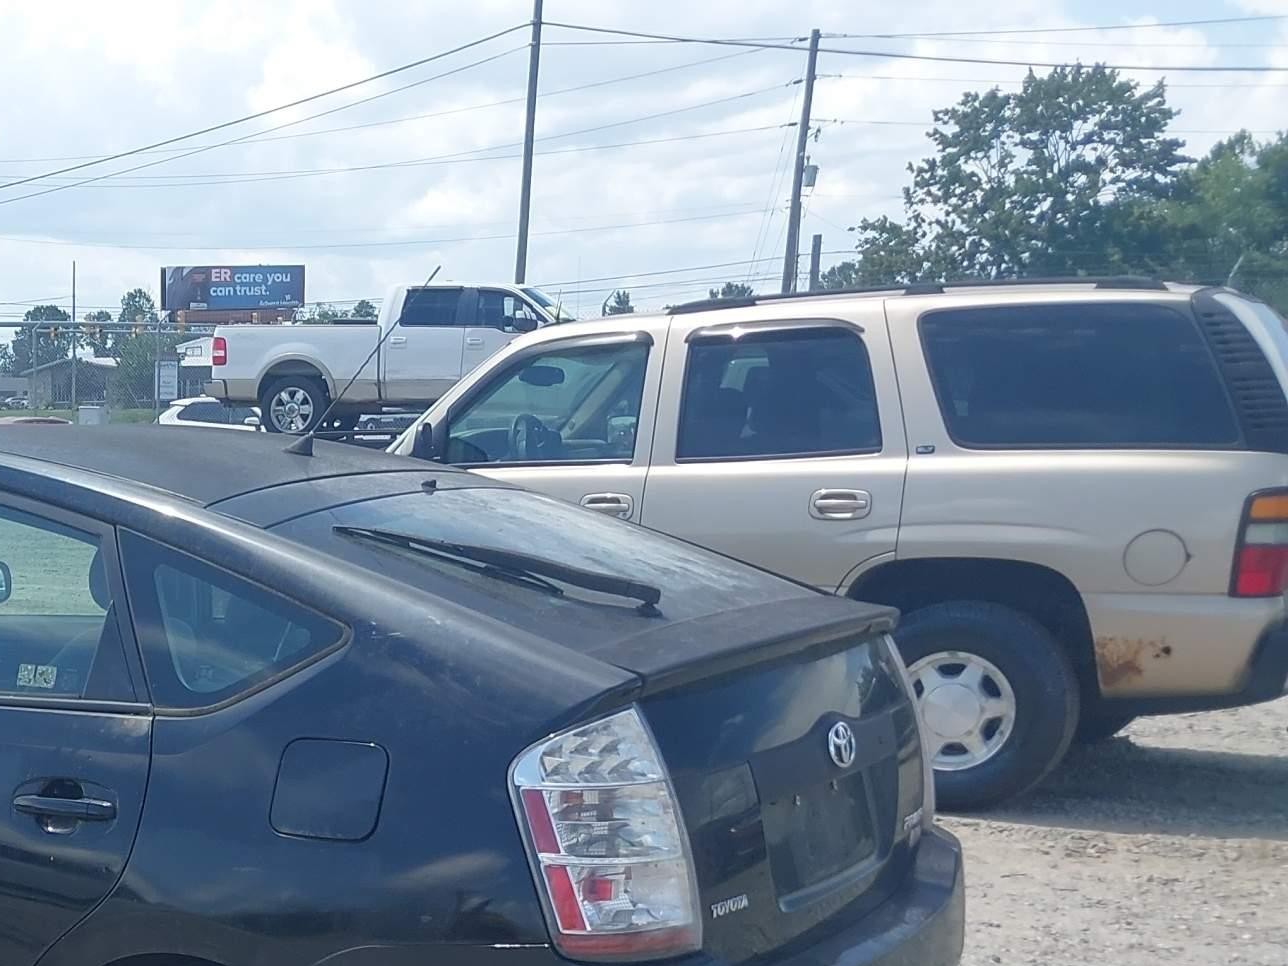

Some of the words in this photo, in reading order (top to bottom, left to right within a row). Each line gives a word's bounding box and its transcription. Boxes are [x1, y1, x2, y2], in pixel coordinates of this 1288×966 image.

[211, 268, 231, 282] ER
[234, 271, 263, 283] care
[267, 271, 291, 286] you
[210, 285, 233, 297] can
[235, 284, 270, 297] trust.
[711, 894, 749, 919] TOYOTA
